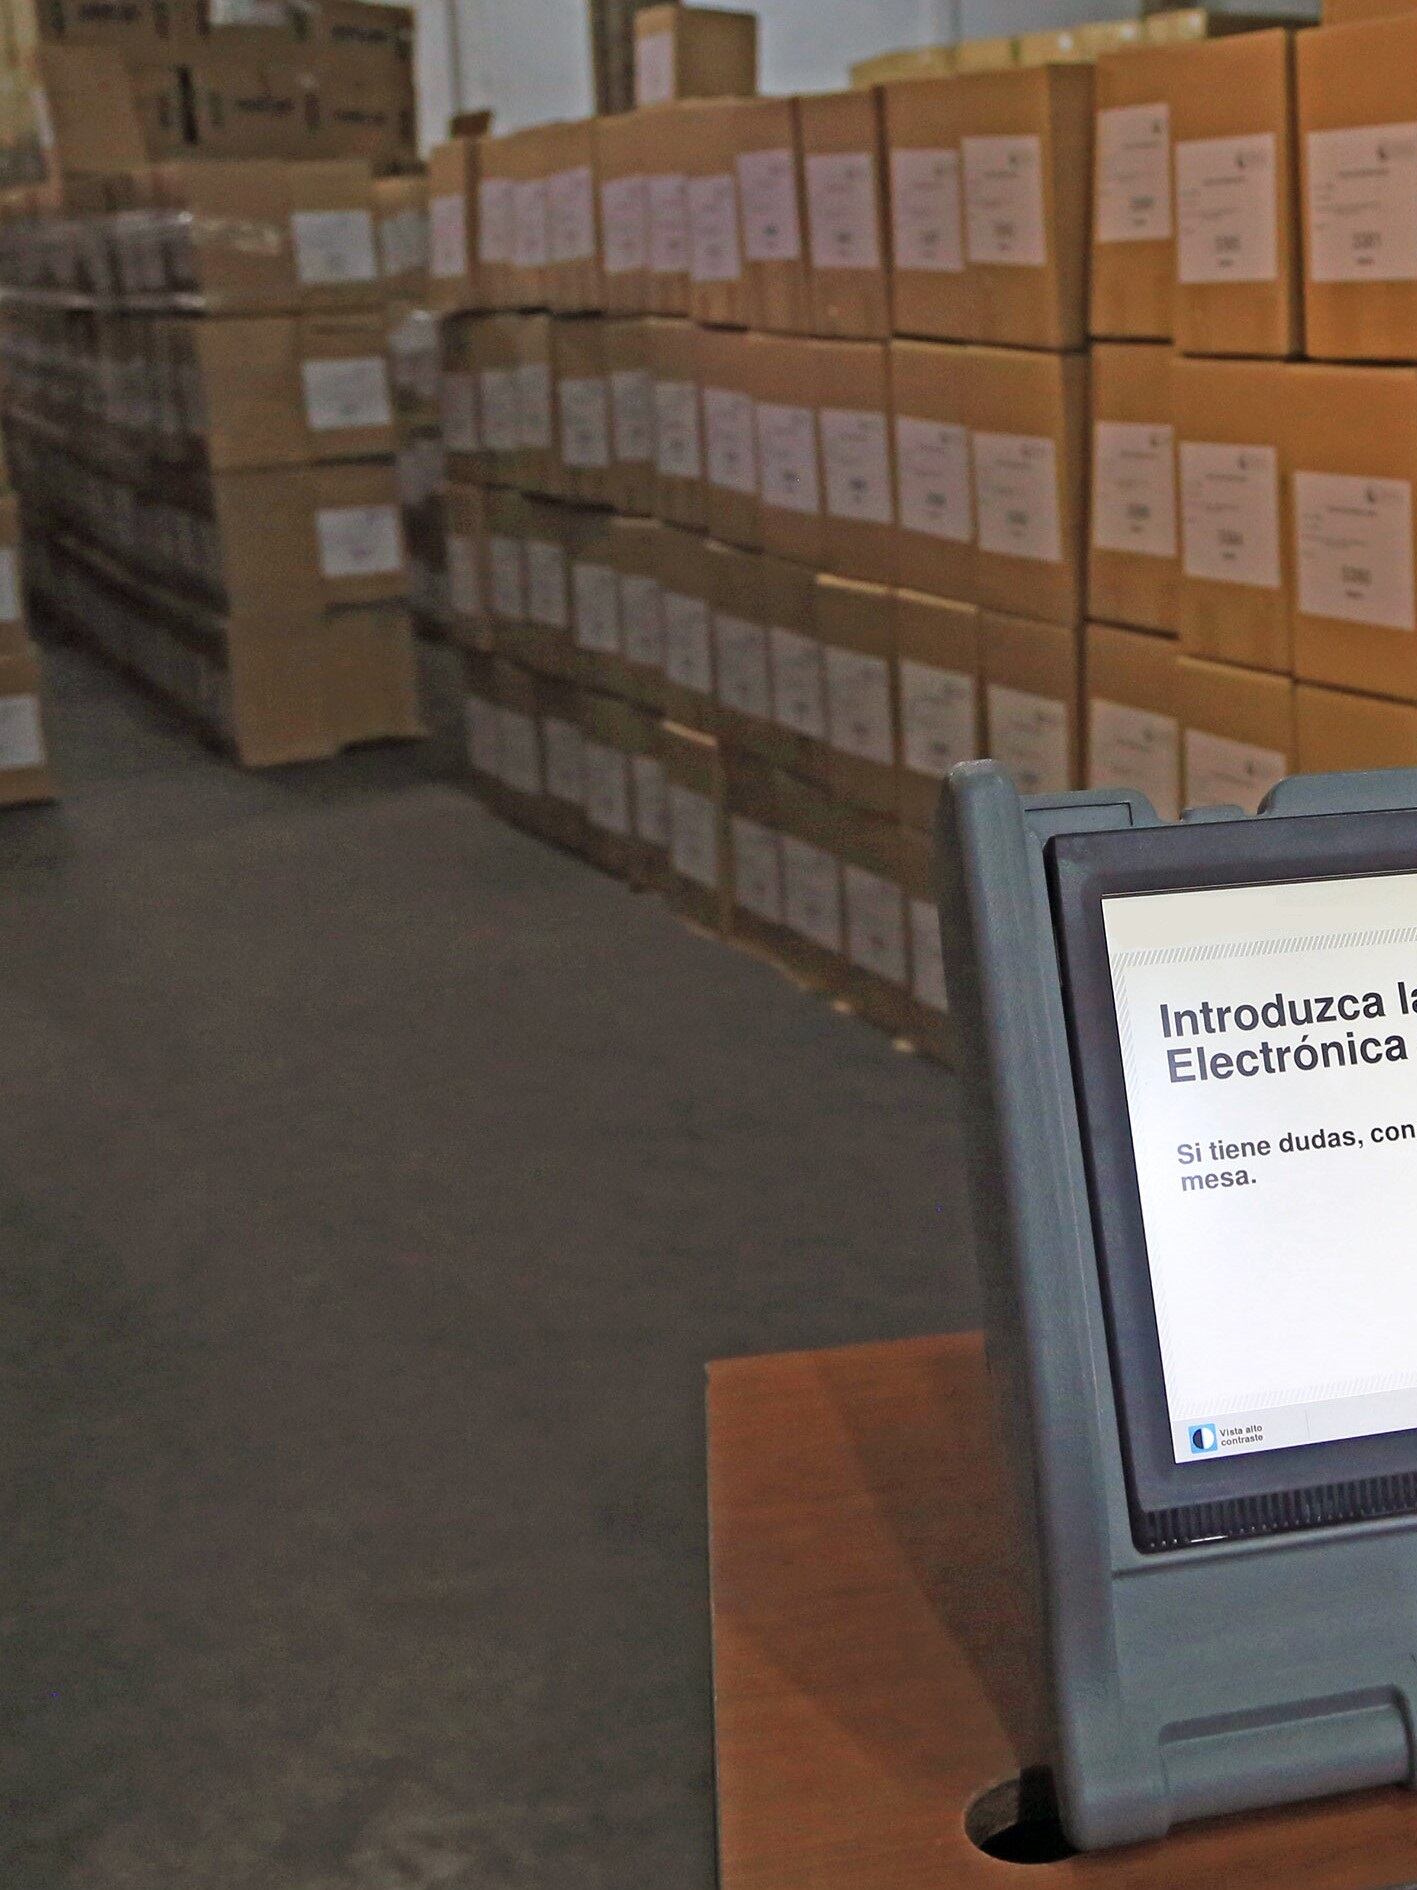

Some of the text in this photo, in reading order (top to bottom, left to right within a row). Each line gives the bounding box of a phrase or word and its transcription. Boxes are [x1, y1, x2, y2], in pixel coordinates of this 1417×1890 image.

[1159, 992, 1387, 1039] Introduzca
[1166, 1031, 1409, 1084] Electrónica
[1176, 1142, 1203, 1165] Si
[1209, 1138, 1272, 1161] tiene
[1278, 1128, 1365, 1154] dudas,
[1181, 1168, 1258, 1192] mesa.
[1219, 1424, 1263, 1437] Vista alto
[1220, 1434, 1264, 1446] contraste
